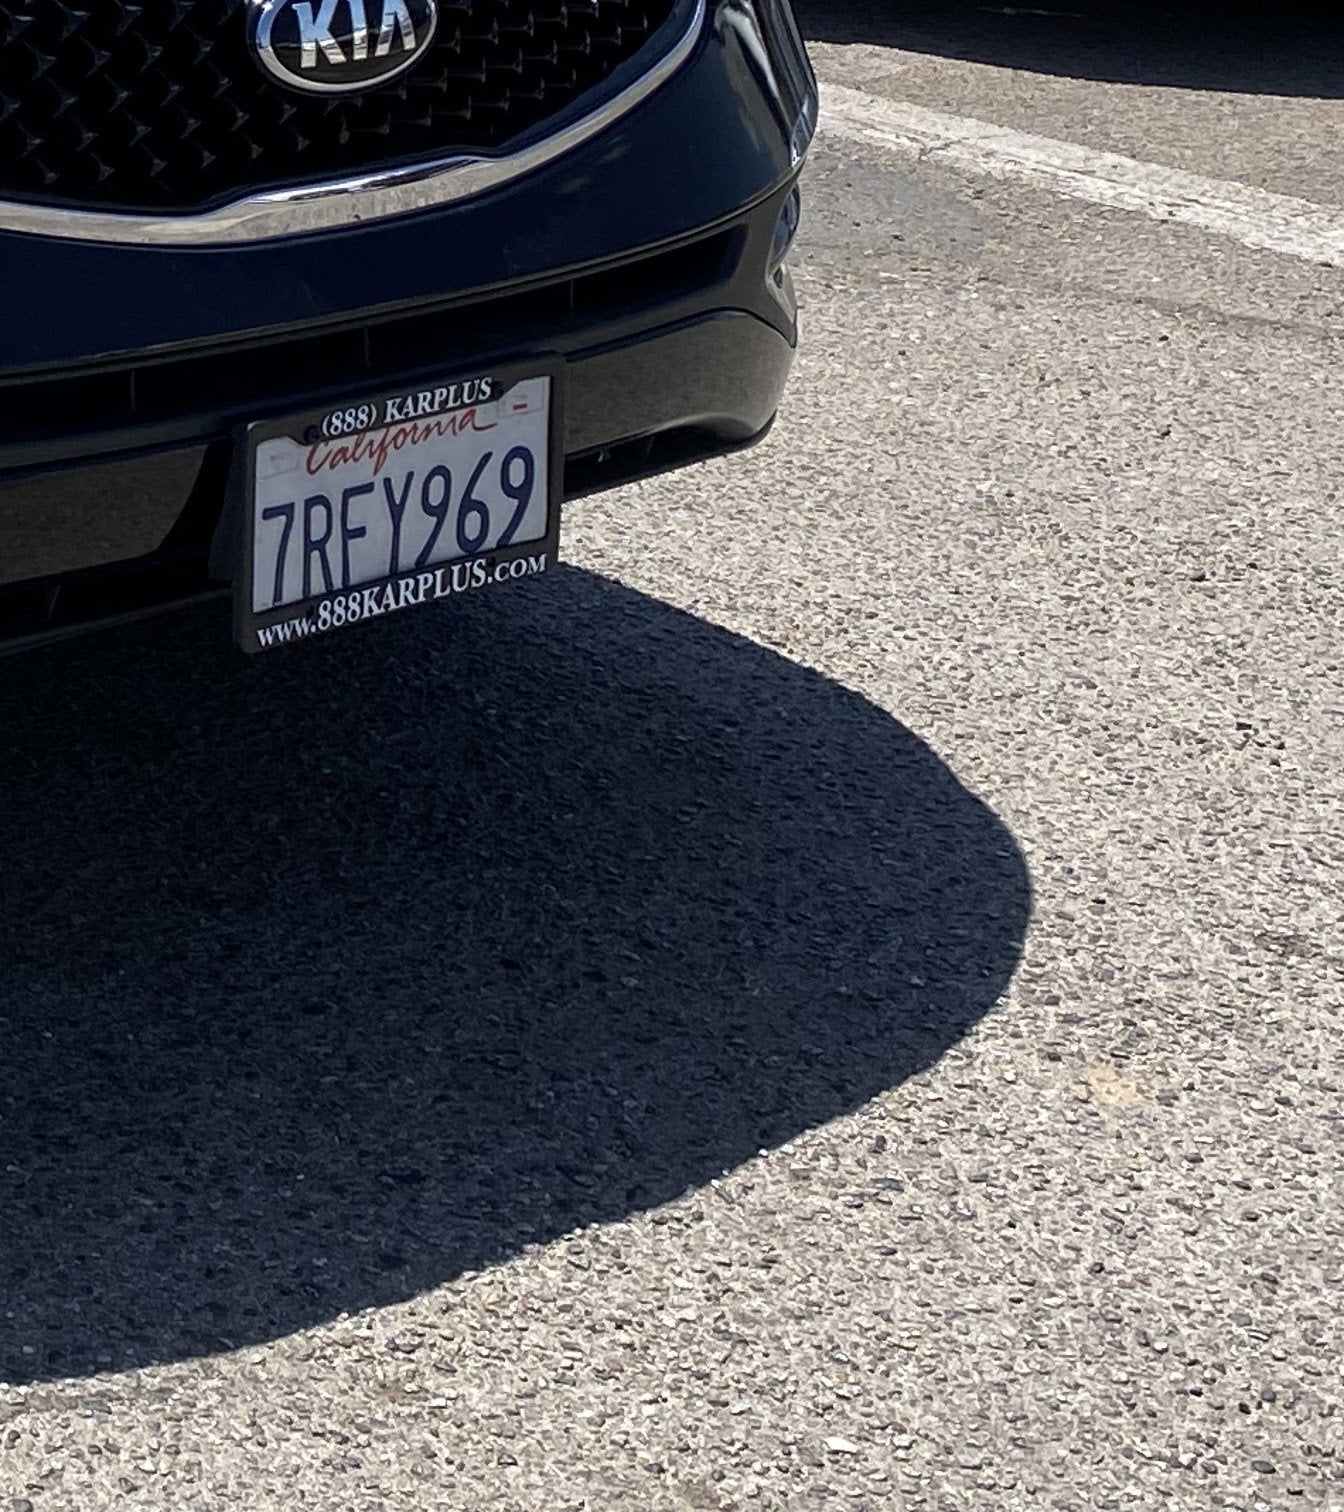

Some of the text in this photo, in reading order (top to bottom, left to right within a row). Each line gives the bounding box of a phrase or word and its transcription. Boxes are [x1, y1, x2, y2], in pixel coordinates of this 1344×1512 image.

[305, 407, 497, 475] California
[321, 377, 492, 437] (888) KARPLUS
[262, 445, 535, 606] 7RFY969
